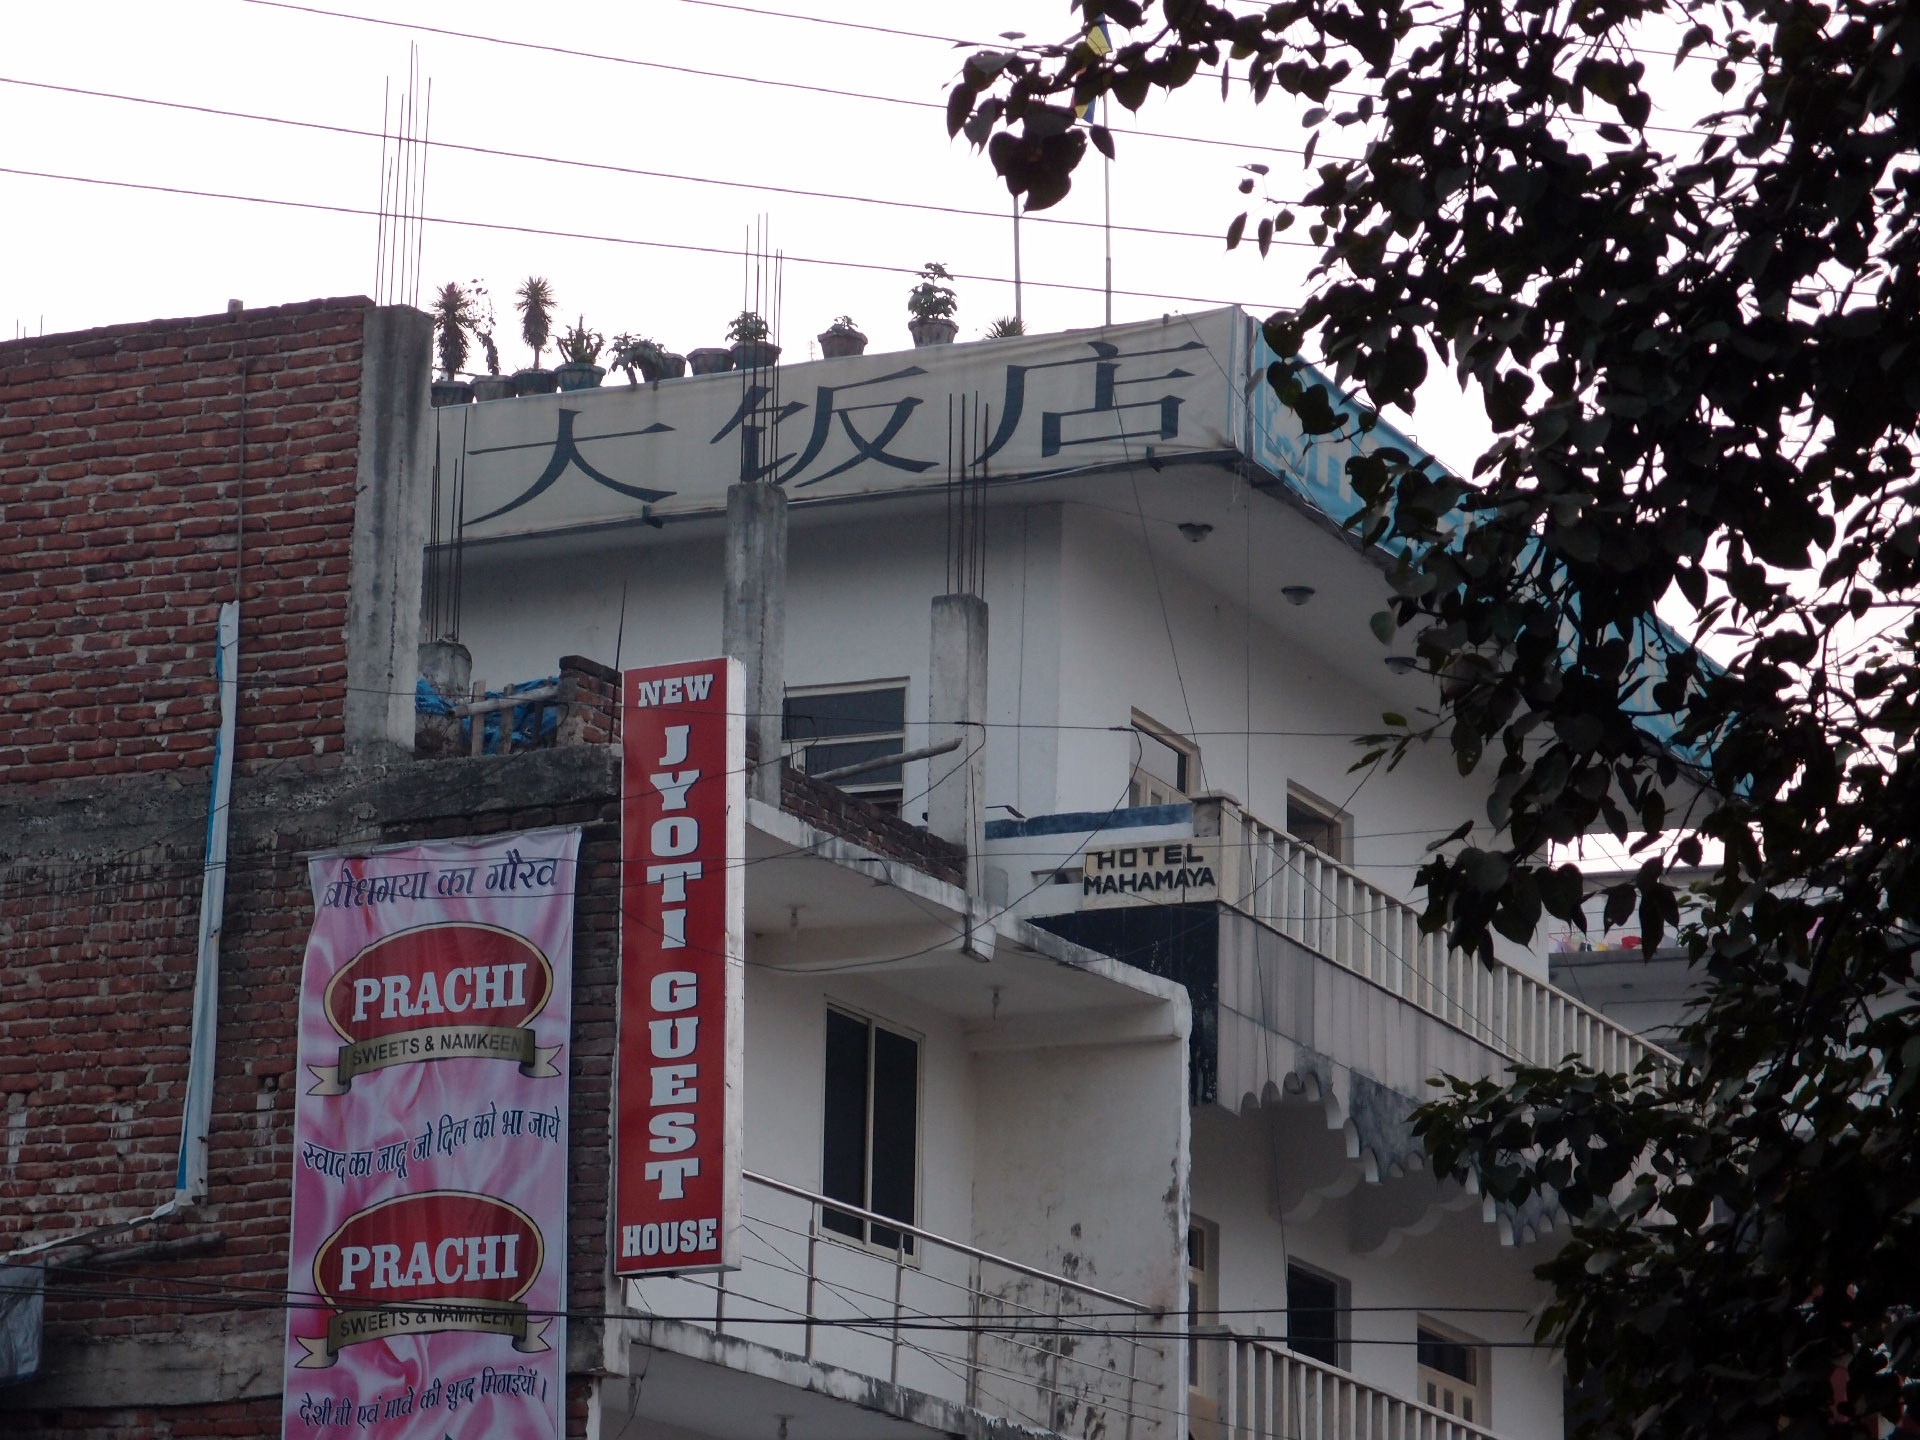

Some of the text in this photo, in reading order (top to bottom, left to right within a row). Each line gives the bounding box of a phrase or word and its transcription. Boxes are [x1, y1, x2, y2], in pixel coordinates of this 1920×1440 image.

[638, 673, 714, 708] NEW
[436, 865, 480, 898] का
[485, 848, 559, 892] गौरव
[1096, 843, 1204, 870] HOTEL
[1083, 866, 1216, 896] MAHAMAYA
[644, 724, 703, 1201] JYOTI GUEST
[352, 962, 528, 1022] PRACHI
[352, 1033, 522, 1066] SWEETS & NAMKEEN
[302, 1100, 562, 1184] स्वाद का जादू जो दिल को भा जाये
[622, 1218, 718, 1258] HOUSE
[338, 1234, 520, 1291] PRACHI
[340, 1310, 410, 1337] SWEETS
[415, 1311, 427, 1325] &
[334, 1397, 353, 1427] घी
[356, 1396, 382, 1430] एवं
[384, 1386, 415, 1420] मावे
[419, 1377, 442, 1410] की
